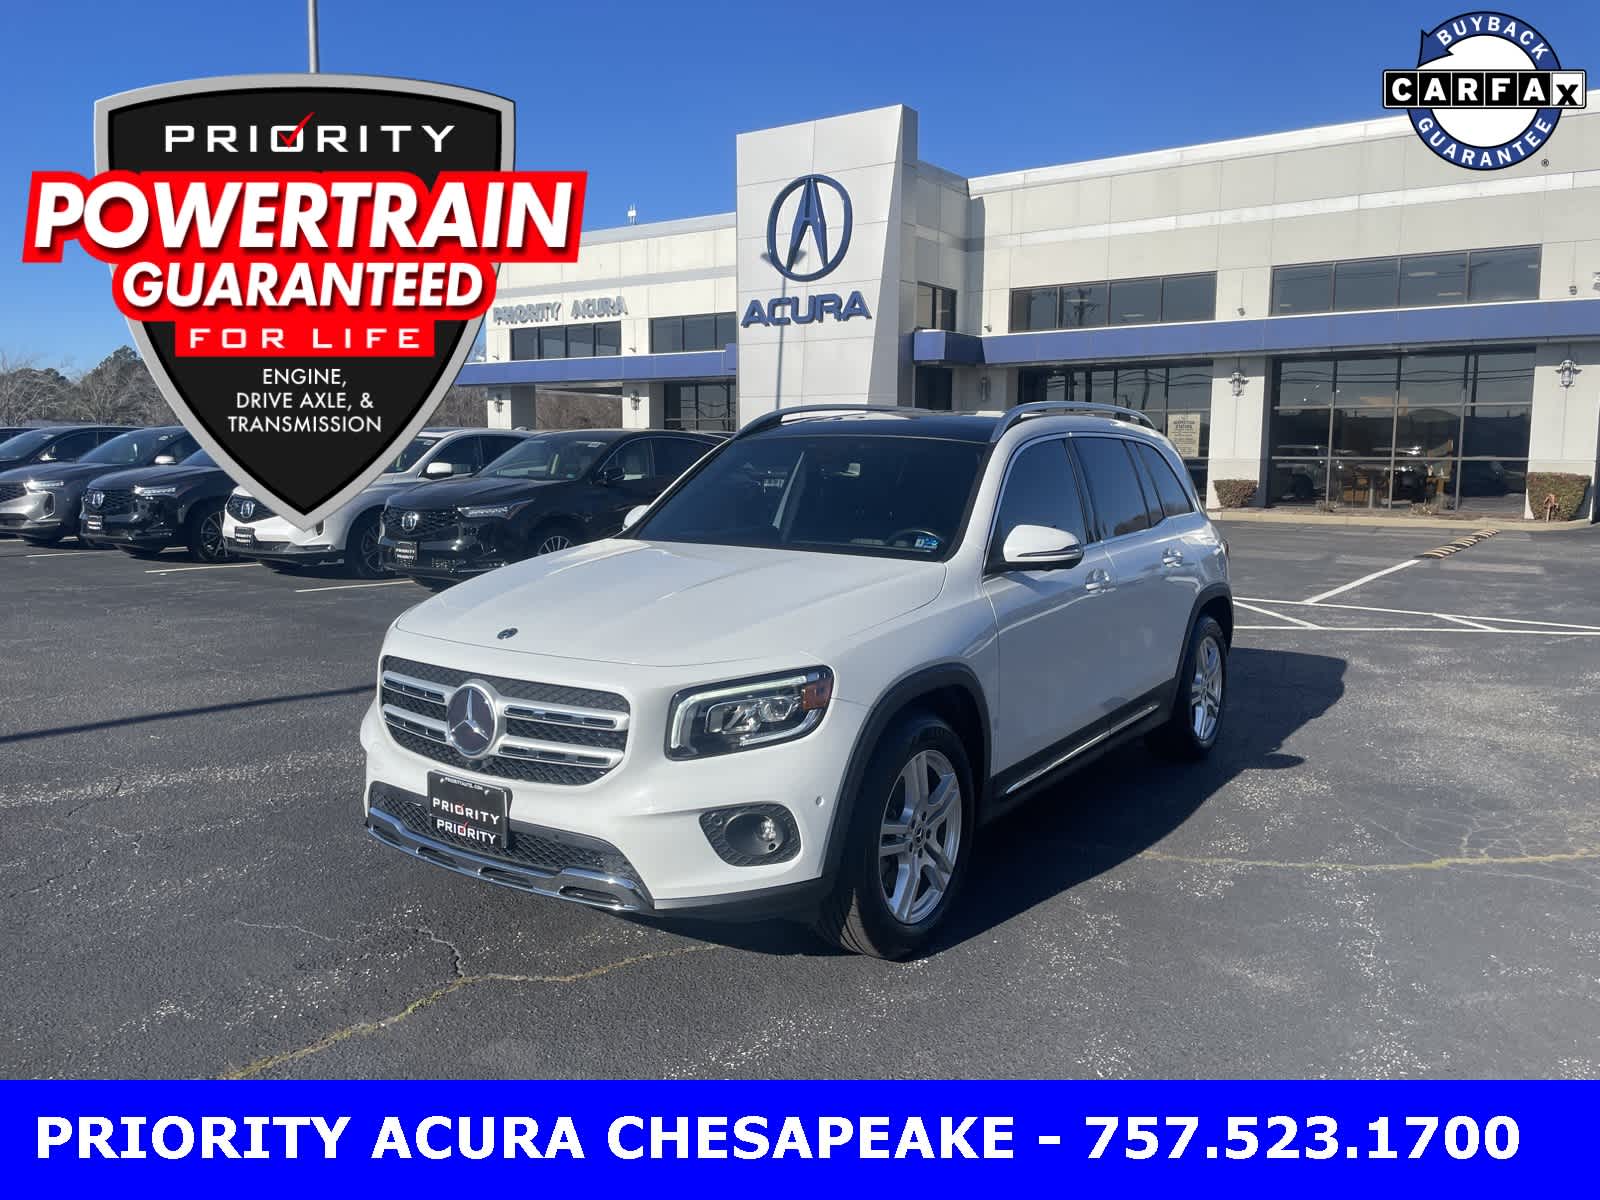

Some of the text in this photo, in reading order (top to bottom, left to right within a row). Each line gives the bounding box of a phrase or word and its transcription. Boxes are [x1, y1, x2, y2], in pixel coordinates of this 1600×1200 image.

[493, 296, 629, 325] PRIORITY ACURA
[740, 290, 872, 328] ACURA
[432, 797, 500, 825] PRIORITY
[436, 819, 496, 845] PRIORITY
